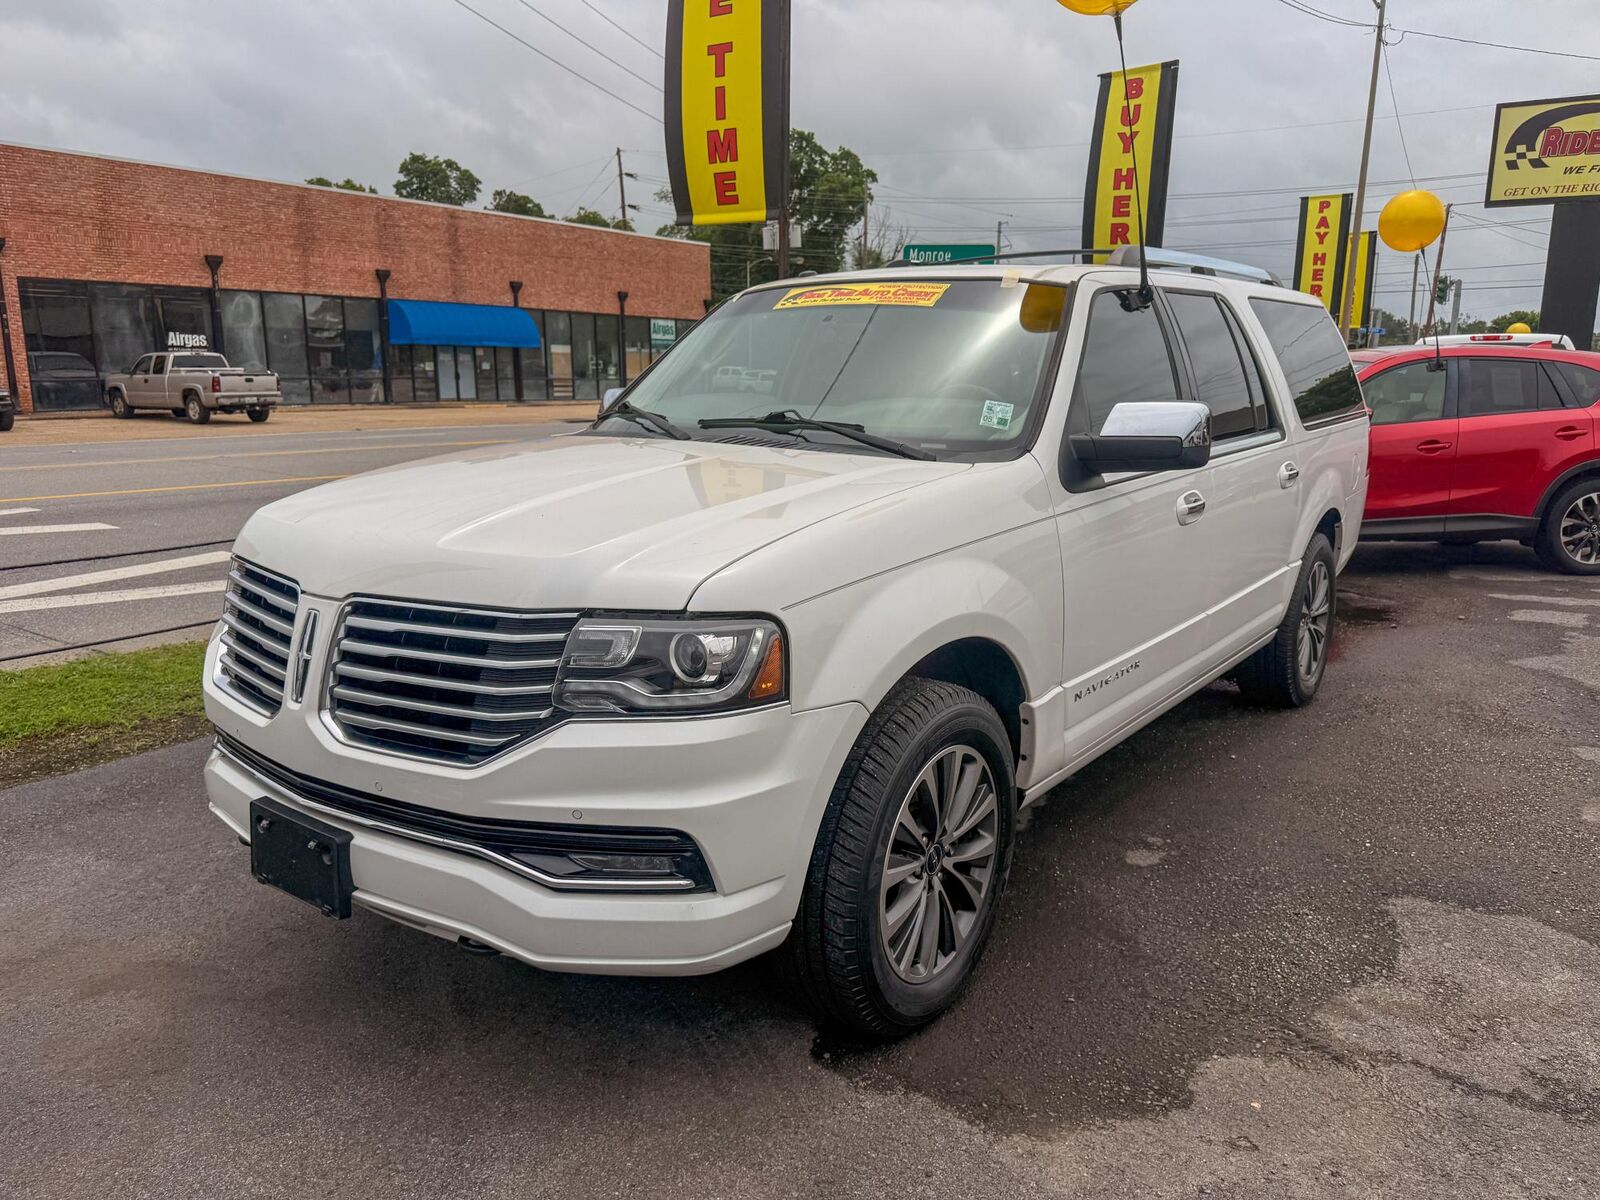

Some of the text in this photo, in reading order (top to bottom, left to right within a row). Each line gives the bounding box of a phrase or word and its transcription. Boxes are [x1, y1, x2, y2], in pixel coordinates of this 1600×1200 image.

[706, 41, 739, 206] TIME
[1117, 77, 1144, 154] BUY
[1539, 126, 1600, 158] RIDE
[1563, 165, 1587, 175] WE
[1503, 186, 1530, 197] GET
[1530, 185, 1551, 196] ON
[1553, 184, 1579, 194] THE
[1315, 200, 1331, 245] PAY
[909, 248, 951, 263] Monroe
[168, 331, 208, 347] Airgas
[652, 321, 674, 336] Airgas
[1074, 659, 1140, 703] NAVIGATOR
